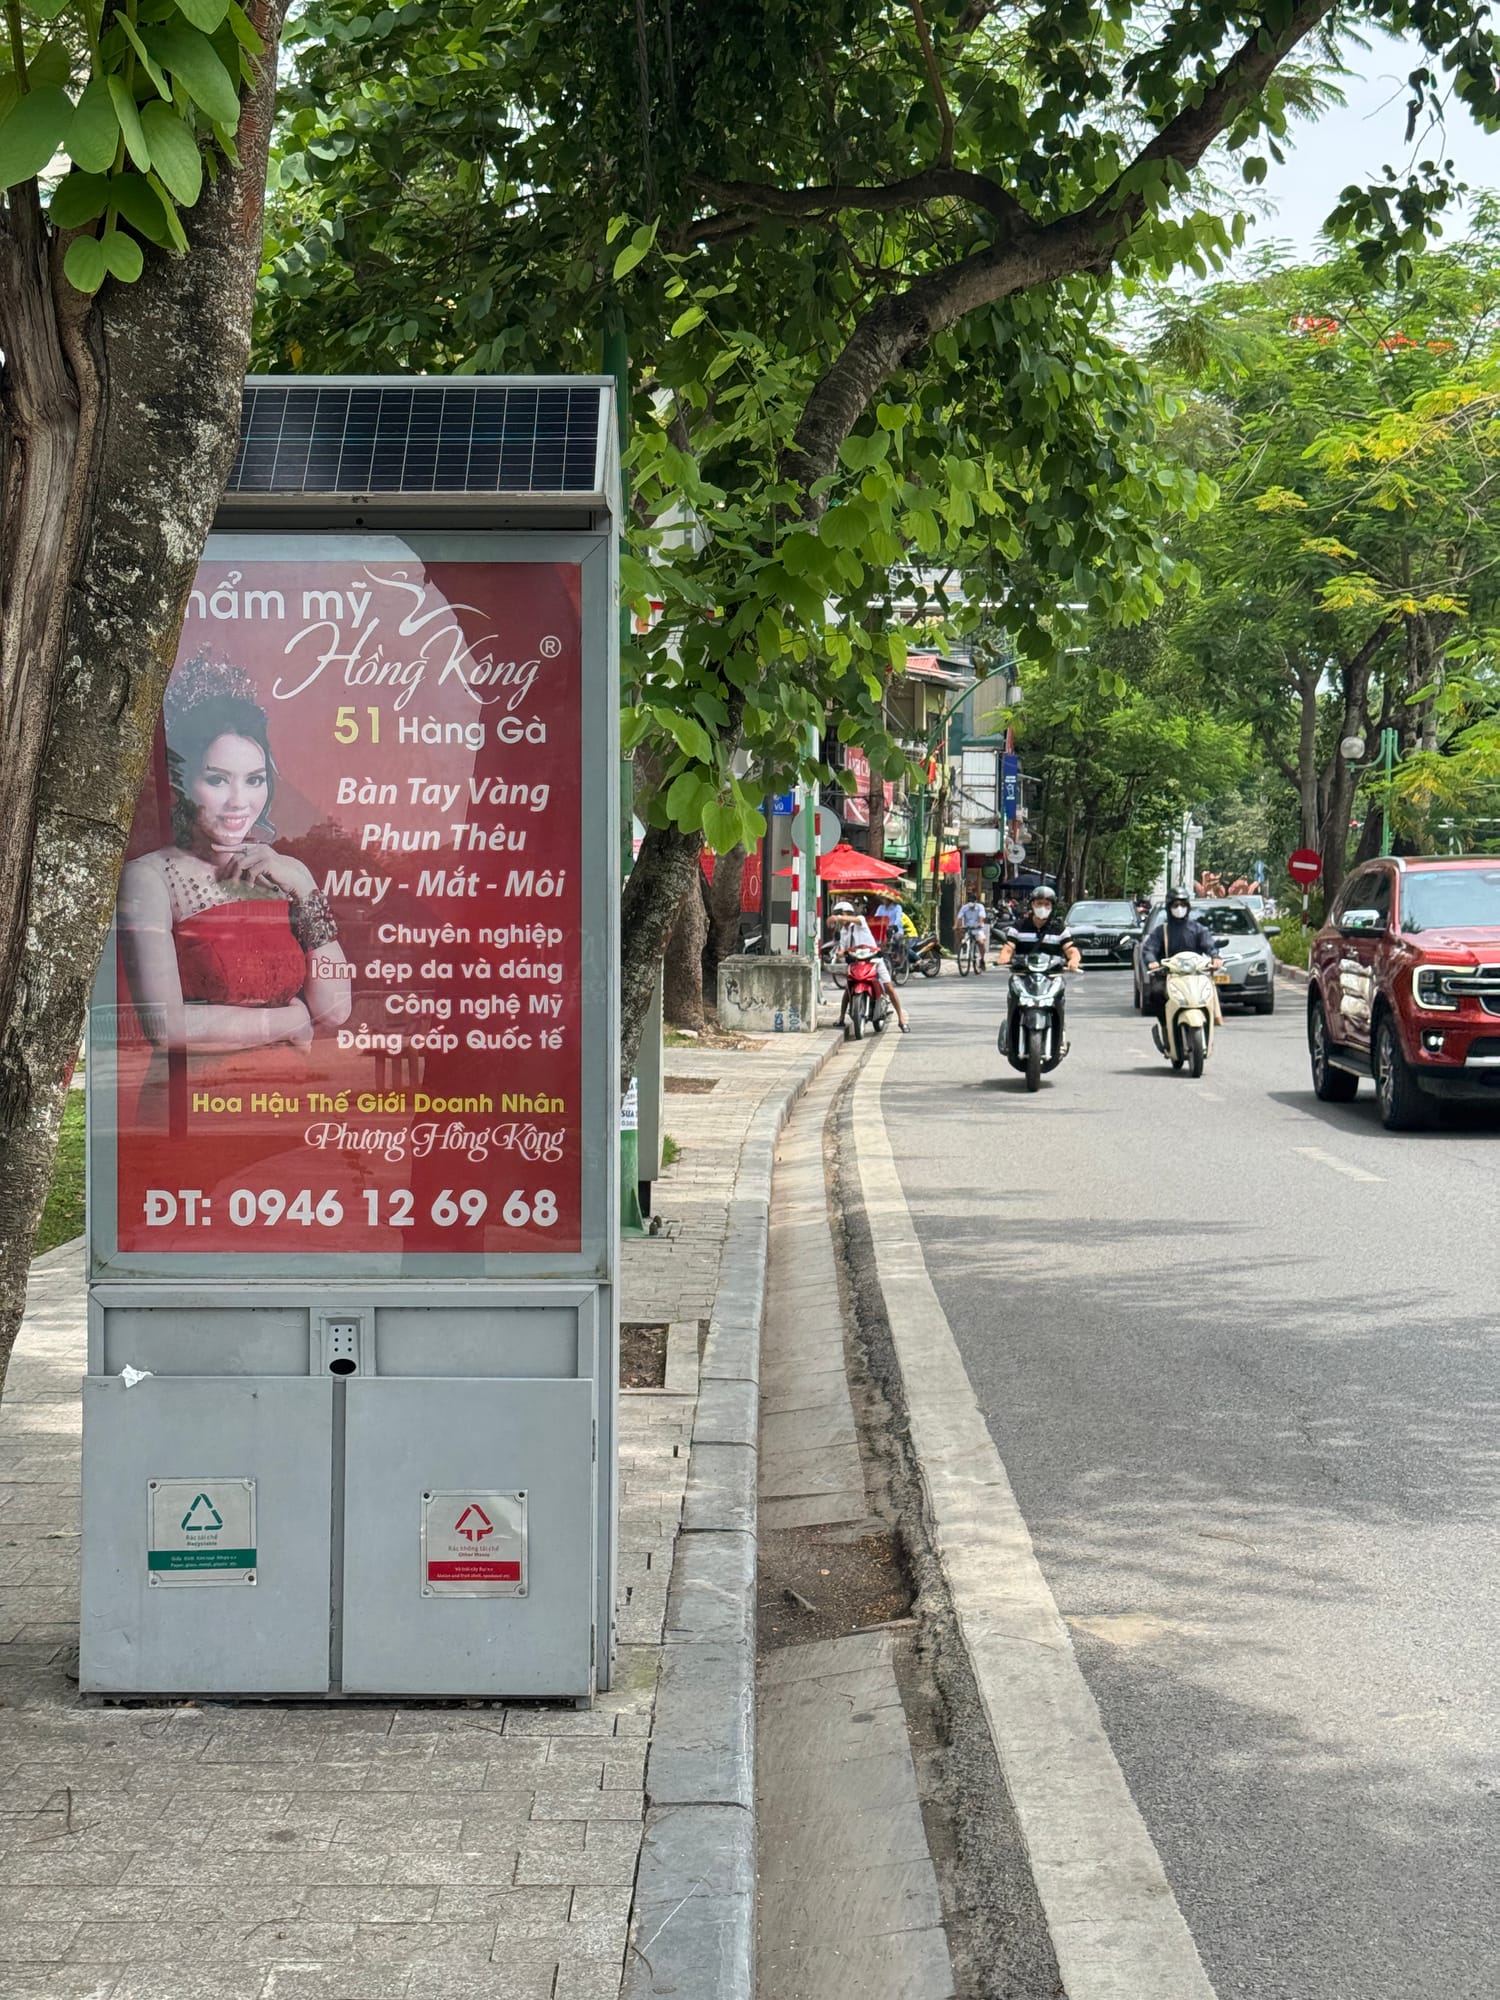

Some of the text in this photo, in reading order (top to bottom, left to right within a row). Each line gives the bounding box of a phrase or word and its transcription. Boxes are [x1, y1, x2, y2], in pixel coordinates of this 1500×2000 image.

[302, 580, 373, 629] mỹ
[272, 617, 428, 711] Hồng
[420, 624, 541, 711] Kông
[334, 706, 547, 751] 51 Hàng Gà
[337, 776, 550, 812] Bàn Tay Vàng
[361, 823, 526, 850] Phun Thêu
[323, 870, 392, 903] Mày
[416, 867, 480, 897] Mắt
[505, 870, 566, 897] Môi
[378, 923, 563, 949] Chuyên nghiệp
[311, 958, 563, 984] làm đẹp da và dáng
[385, 993, 563, 1019] Công nghệ Mỹ
[337, 1023, 565, 1054] Đẳng cấp Quốc tế
[193, 1089, 565, 1117] Hoa Hậu Thế Giới Doanh Nhân
[304, 1121, 566, 1163] Phượng Hồng Kông
[144, 1189, 559, 1227] ĐT: 0946 12 69 68
